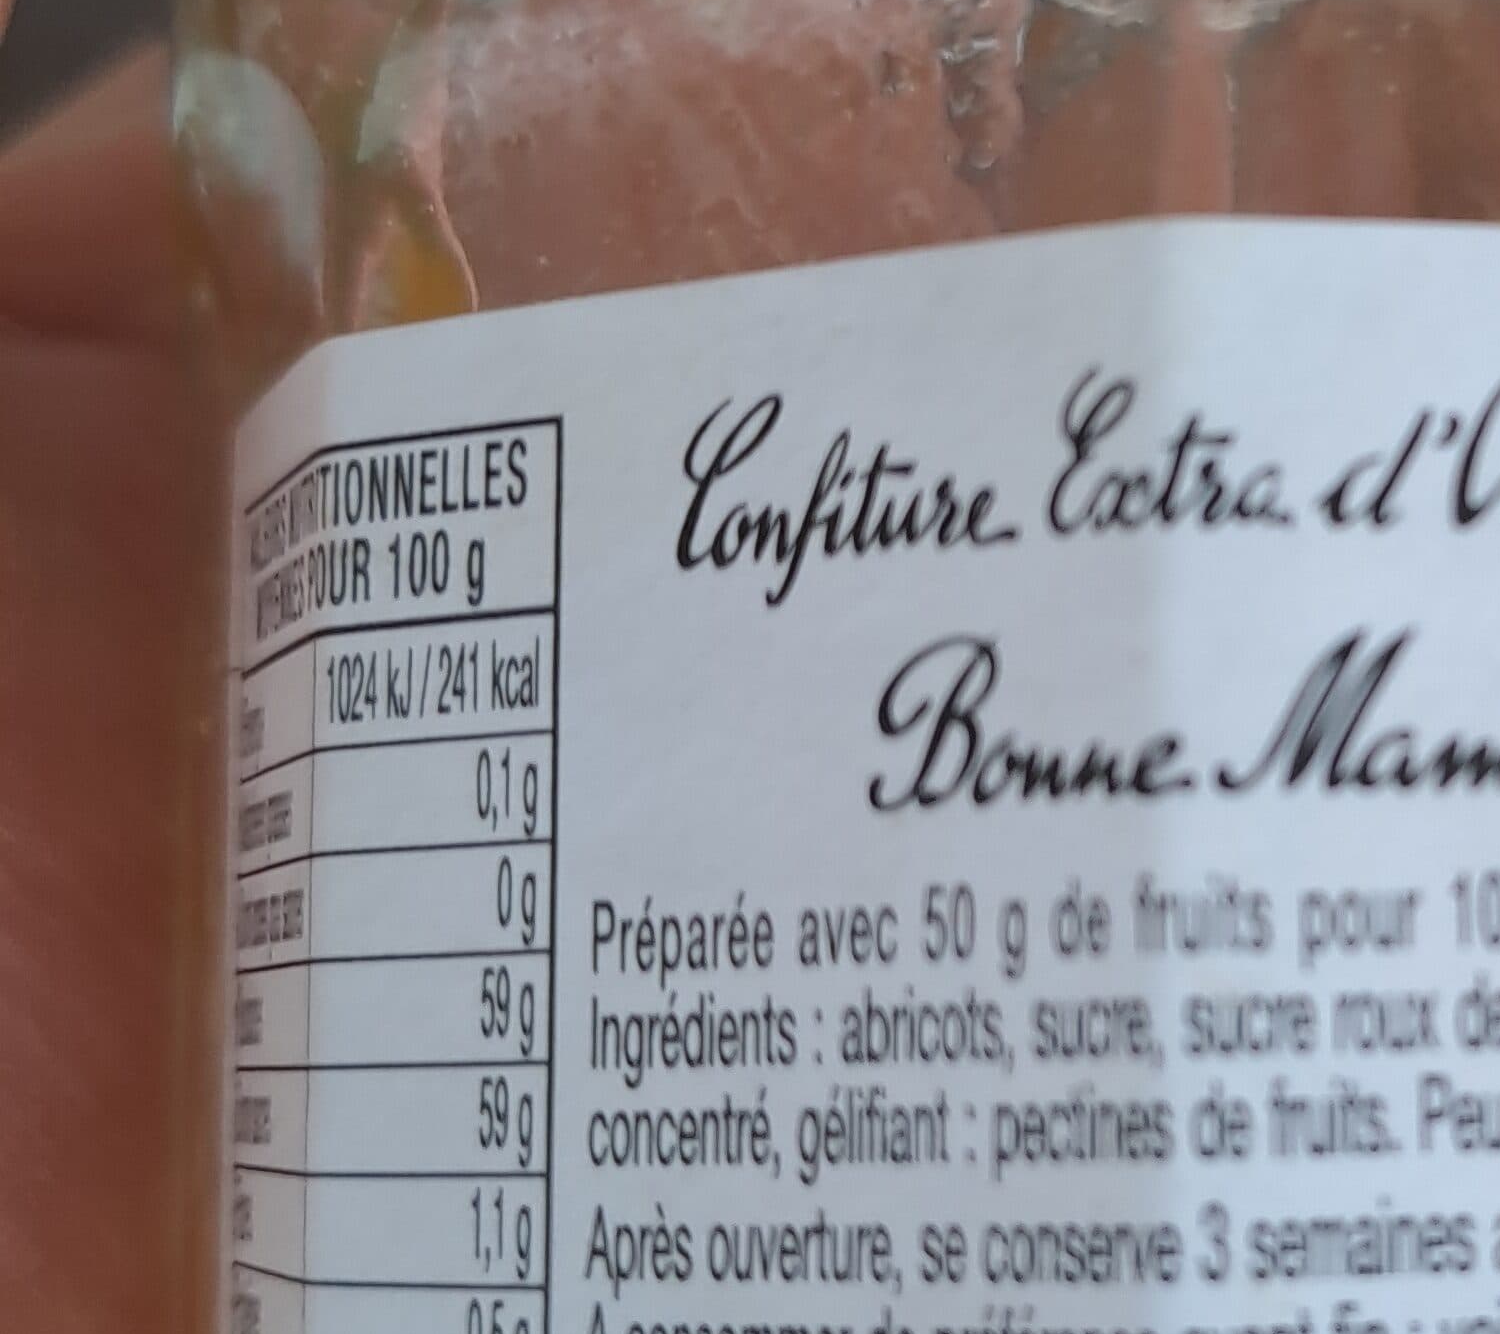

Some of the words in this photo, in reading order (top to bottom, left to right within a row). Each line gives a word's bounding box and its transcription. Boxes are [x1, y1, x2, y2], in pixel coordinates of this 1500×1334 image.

[677, 393, 1022, 607] Confiture
[1050, 364, 1296, 537] Extra
[388, 530, 449, 599] 100
[466, 537, 485, 606] g
[327, 649, 377, 724] 1024
[386, 645, 413, 718] kJ
[437, 642, 479, 715] 241
[491, 636, 539, 711] kcal
[869, 635, 1197, 811] Bonne
[476, 747, 511, 832] 0,1
[522, 762, 537, 839] g
[497, 857, 513, 927] 0
[520, 873, 536, 946] g
[591, 889, 775, 990] Préparée
[799, 903, 898, 966] avec
[923, 882, 976, 962] 50
[1003, 897, 1028, 979] g
[1050, 873, 1112, 954] de
[1134, 870, 1272, 951] fruits
[1297, 888, 1418, 973] pour
[481, 966, 510, 1038] 59
[520, 982, 535, 1057] g
[591, 989, 796, 1089] Ingrédients
[842, 985, 1014, 1074] abricots,
[1032, 996, 1164, 1068] sucre,
[1184, 993, 1316, 1057] sucre
[1332, 990, 1441, 1051] roux
[479, 1076, 509, 1149] 59
[518, 1093, 534, 1167] g
[589, 1085, 781, 1179] concentré,
[799, 1083, 950, 1186] gélifiant
[992, 1082, 1174, 1182] pectines
[1190, 1078, 1251, 1159] de
[472, 1186, 505, 1272] 1,1
[517, 1204, 532, 1279] g
[585, 1202, 693, 1300] Après
[709, 1208, 902, 1294] ouverture,
[922, 1223, 967, 1283] se
[984, 1220, 1182, 1283] conserve
[1199, 1199, 1231, 1282] 3
[1250, 1194, 1473, 1279] semaines
